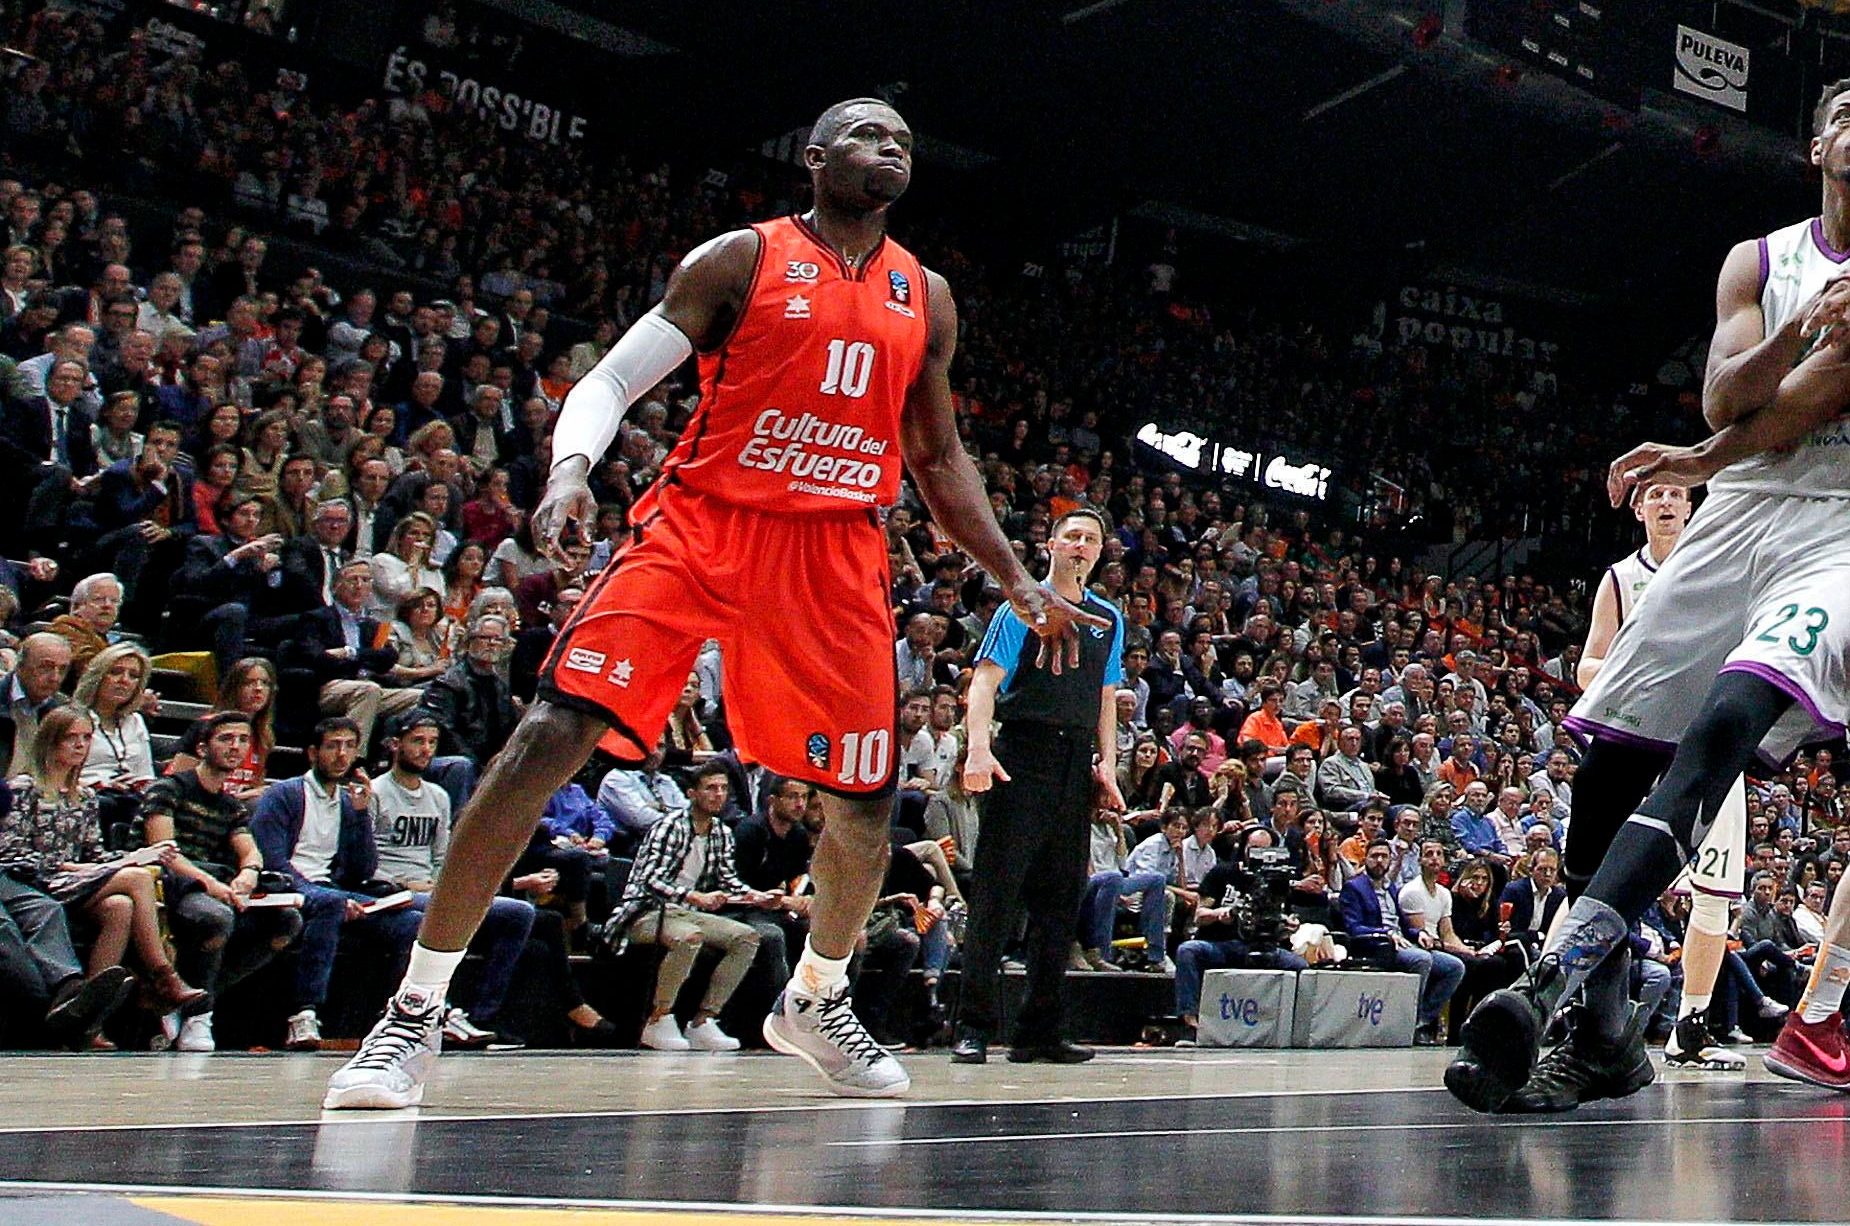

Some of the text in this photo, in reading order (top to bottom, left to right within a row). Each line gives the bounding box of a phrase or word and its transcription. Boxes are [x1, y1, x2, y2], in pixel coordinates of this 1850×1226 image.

[1680, 34, 1745, 73] PULEVA
[785, 260, 820, 279] 30
[819, 339, 876, 398] 10
[753, 408, 888, 456] Cultura del
[737, 437, 882, 488] Esfuerzo
[1756, 602, 1829, 656] 23
[837, 728, 890, 786] 10
[1701, 847, 1730, 879] 21
[1218, 991, 1259, 1026] tve
[1357, 991, 1384, 1026] tve
